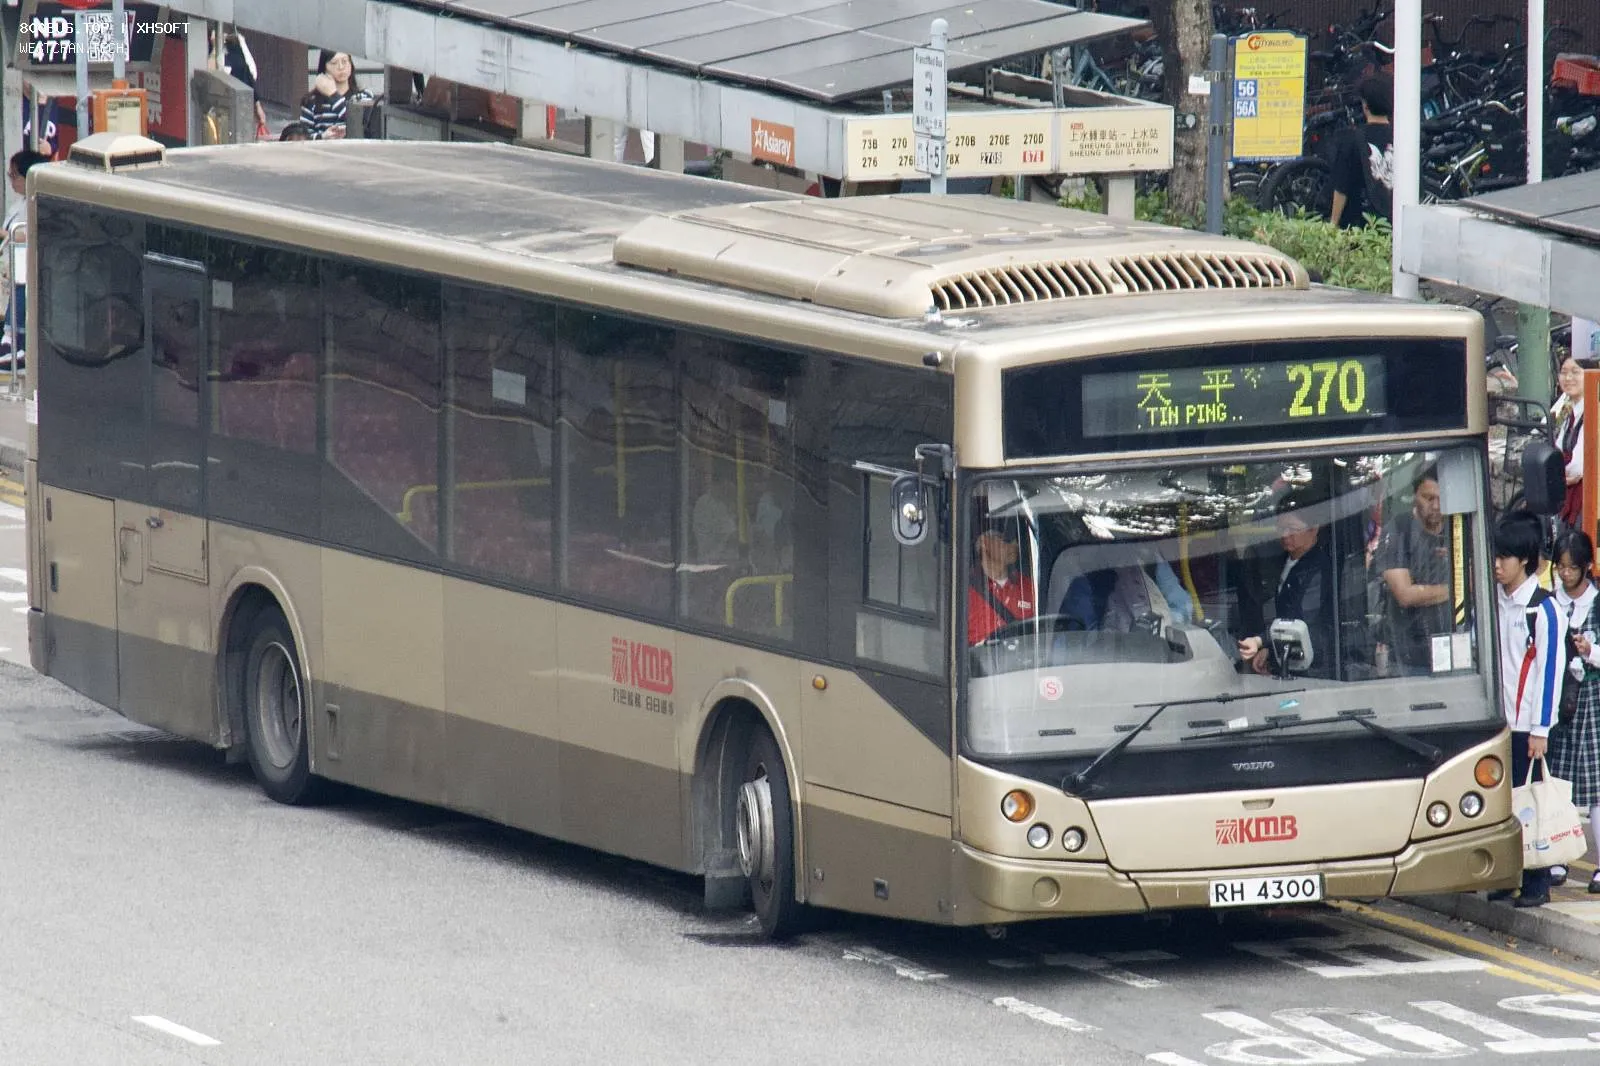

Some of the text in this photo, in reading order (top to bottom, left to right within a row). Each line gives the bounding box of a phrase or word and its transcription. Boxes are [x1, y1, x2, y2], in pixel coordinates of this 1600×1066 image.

[1238, 81, 1255, 97] 56
[1236, 100, 1256, 116] 56A
[763, 130, 791, 162] Asiaray
[862, 133, 1044, 150] 73B 270 270B 270E 270D
[862, 157, 878, 168] 276
[1287, 360, 1366, 417] 270
[1147, 403, 1227, 426] TIN PING
[631, 641, 673, 695] KMB
[1232, 760, 1275, 771] VOLVO
[1239, 815, 1298, 844] KMB
[1215, 878, 1316, 902] RH 4300
